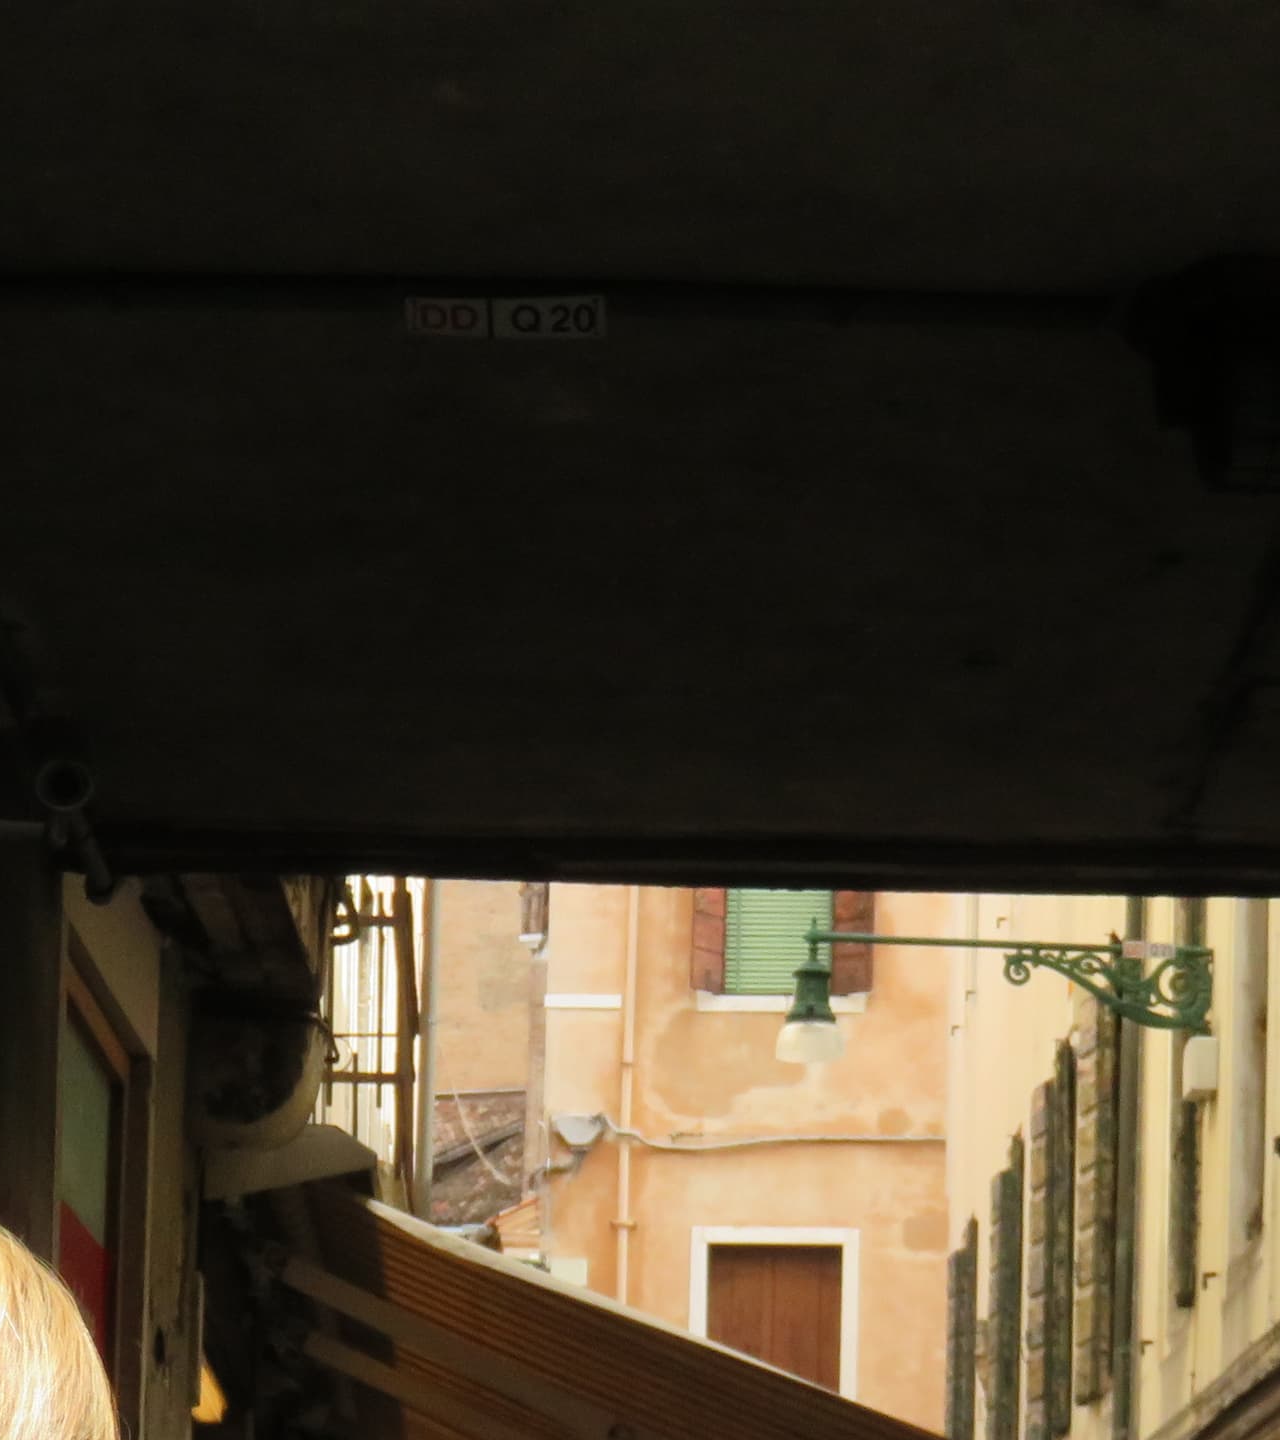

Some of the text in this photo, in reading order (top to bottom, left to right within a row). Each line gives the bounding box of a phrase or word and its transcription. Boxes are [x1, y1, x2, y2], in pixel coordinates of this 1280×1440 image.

[421, 304, 596, 334] DD Q 20
